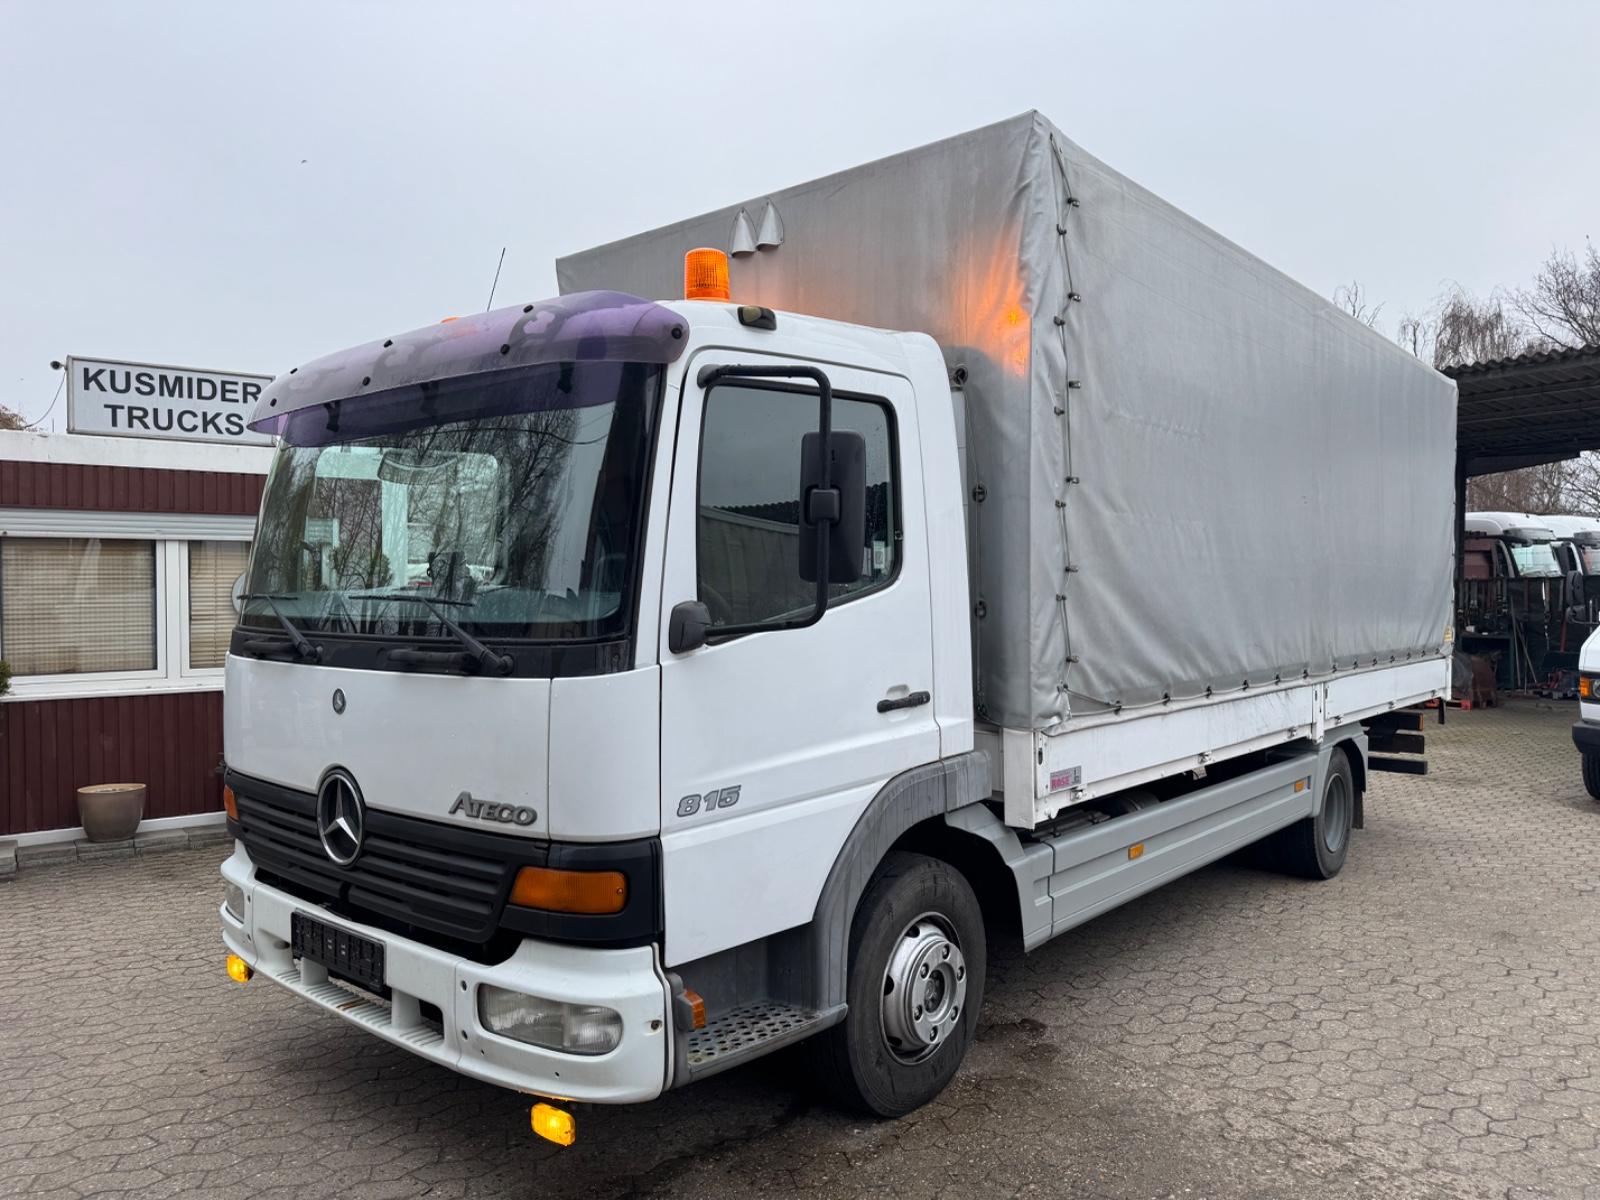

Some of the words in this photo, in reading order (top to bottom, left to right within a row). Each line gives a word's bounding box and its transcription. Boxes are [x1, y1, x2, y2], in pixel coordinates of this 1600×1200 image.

[83, 367, 262, 404] KUSMIDER
[103, 404, 244, 436] TRUCKS
[676, 784, 742, 818] 815
